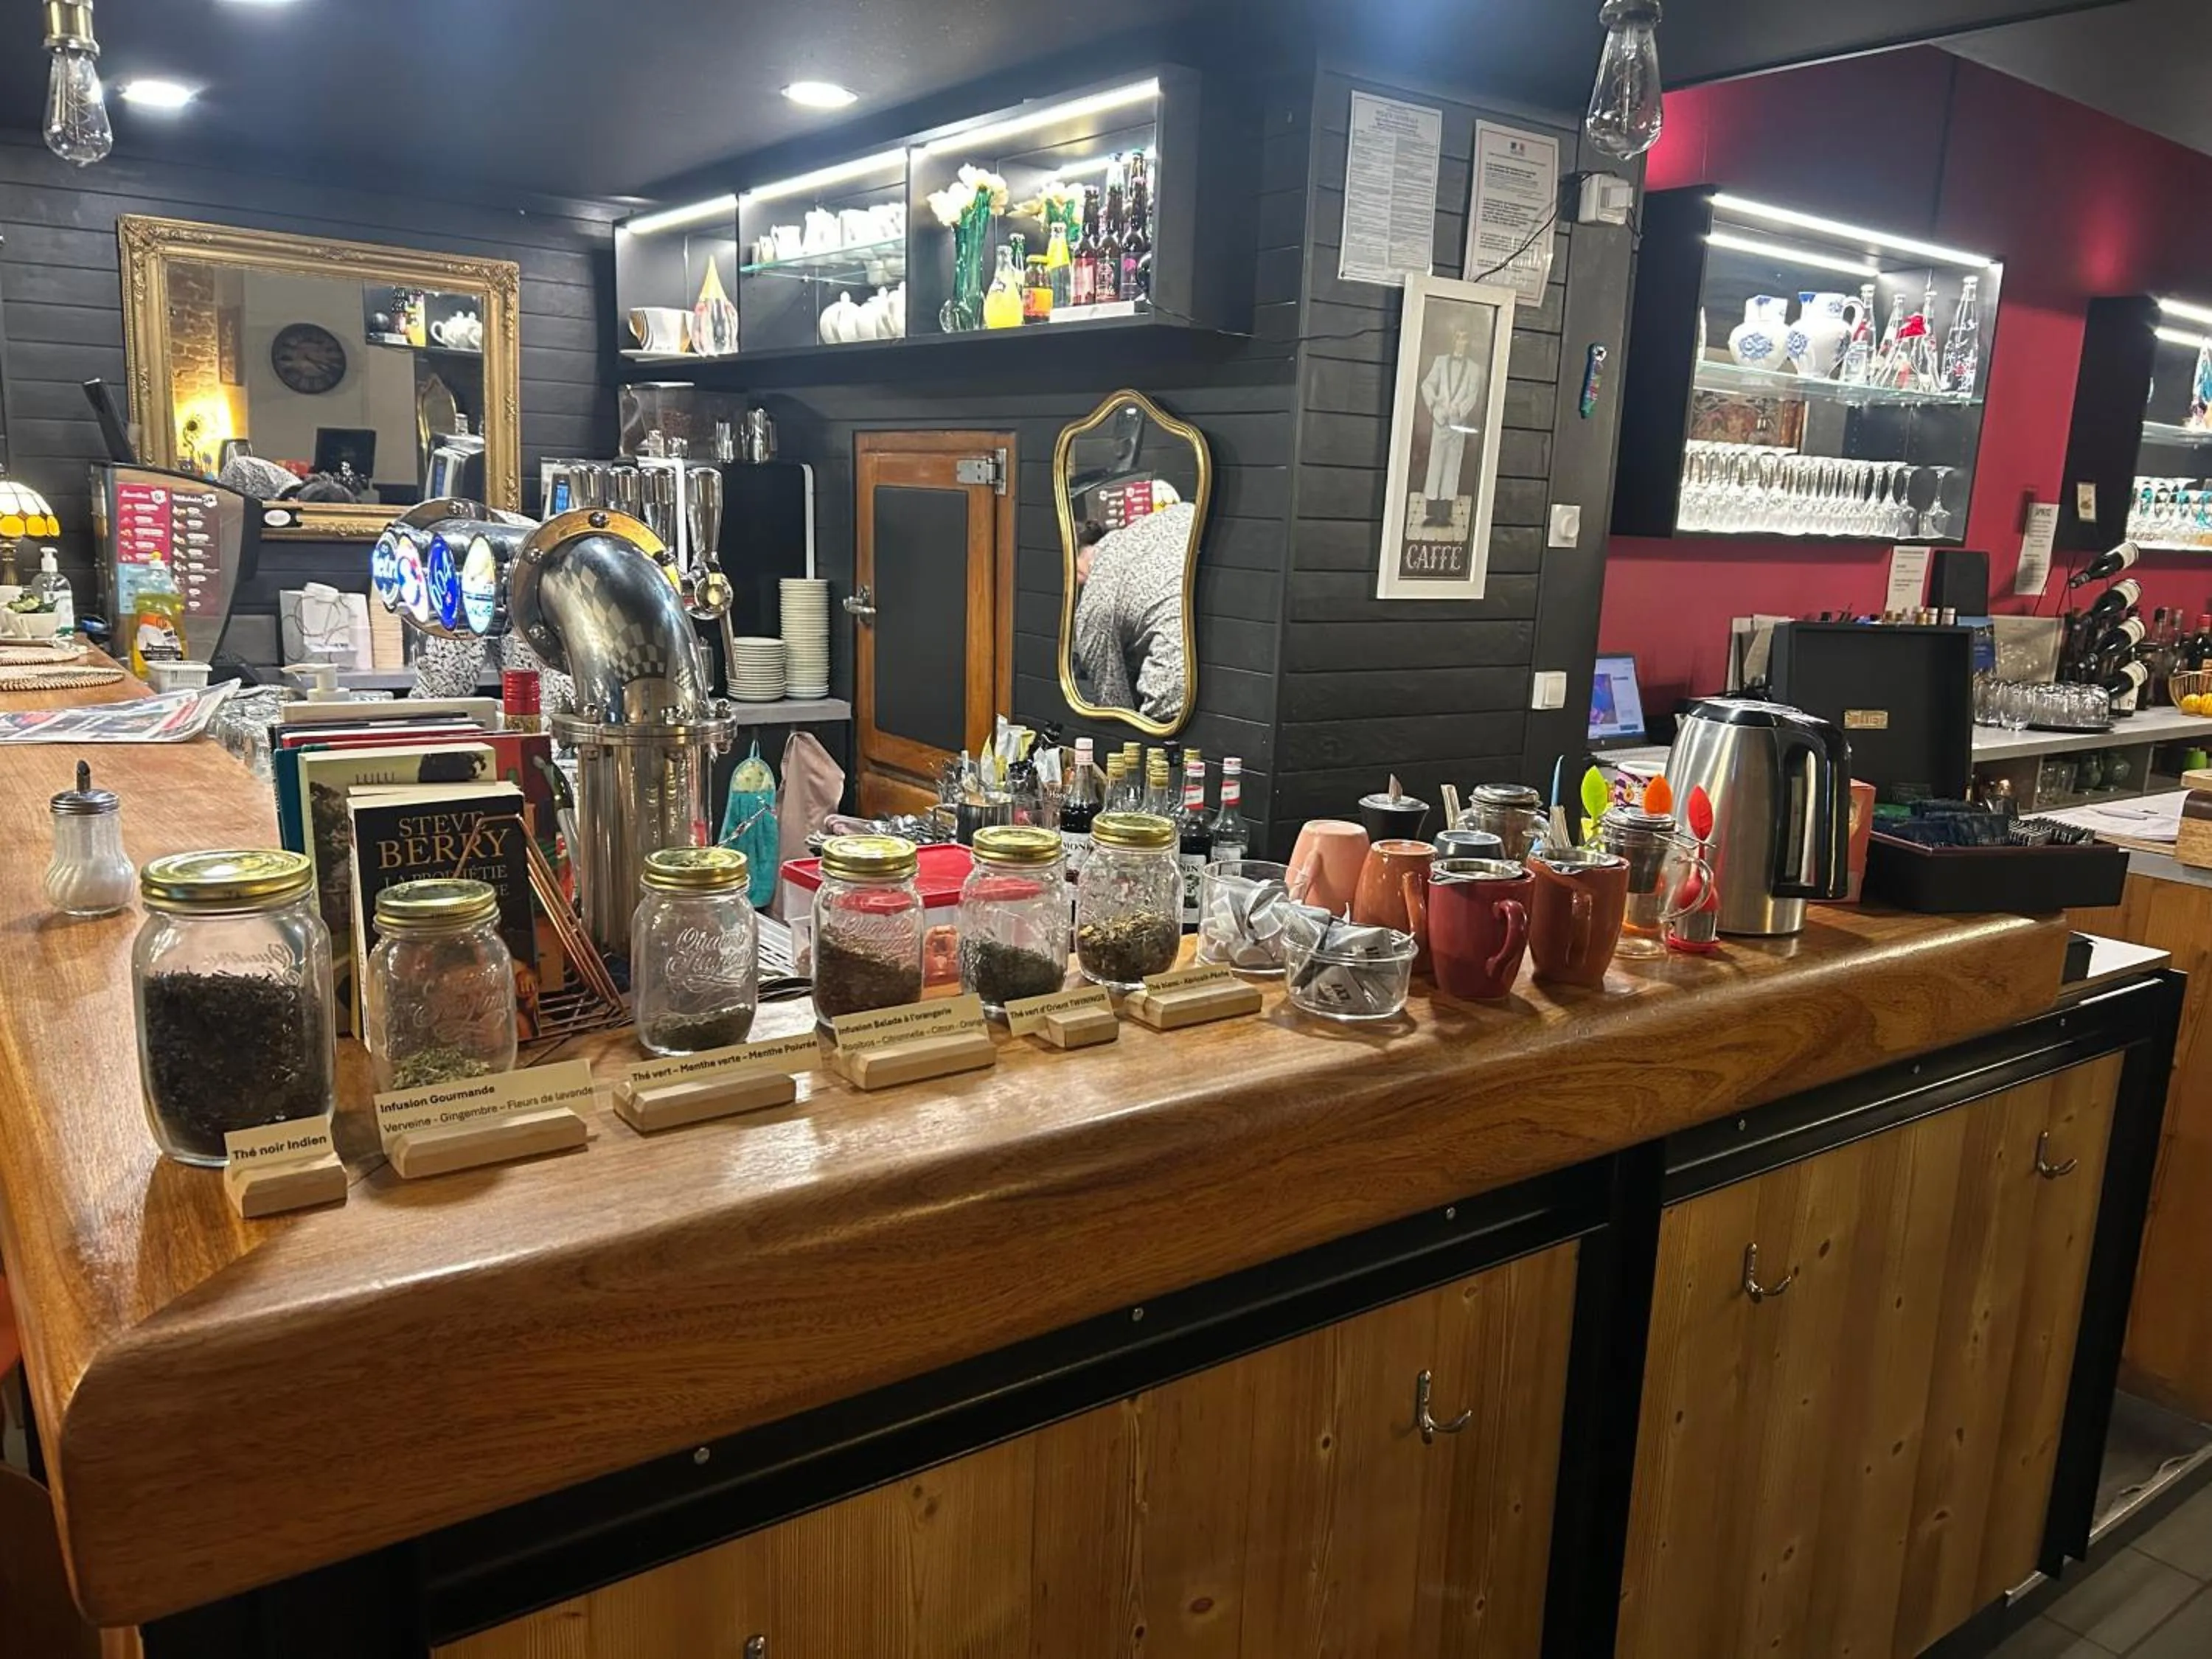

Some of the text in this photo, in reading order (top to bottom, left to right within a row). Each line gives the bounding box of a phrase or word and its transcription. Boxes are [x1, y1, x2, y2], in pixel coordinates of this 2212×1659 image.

[399, 811, 485, 838] STEVE
[376, 827, 511, 869] BERRY
[1010, 1010, 1023, 1019] Thé
[838, 1023, 872, 1035] Infusion
[632, 1071, 650, 1081] Thé
[652, 1068, 672, 1079] vert
[680, 1060, 716, 1073] Menthe
[717, 1055, 741, 1067] verte
[749, 1047, 783, 1060] Menthe
[380, 1085, 495, 1113] Infusion Gourmande
[383, 1119, 431, 1133] Verveine
[439, 1106, 498, 1123] Gingembre
[507, 1097, 539, 1110] Fleurs
[540, 1093, 554, 1104] de
[555, 1086, 594, 1101] lavande
[233, 1135, 327, 1160] Thé noir Indien
